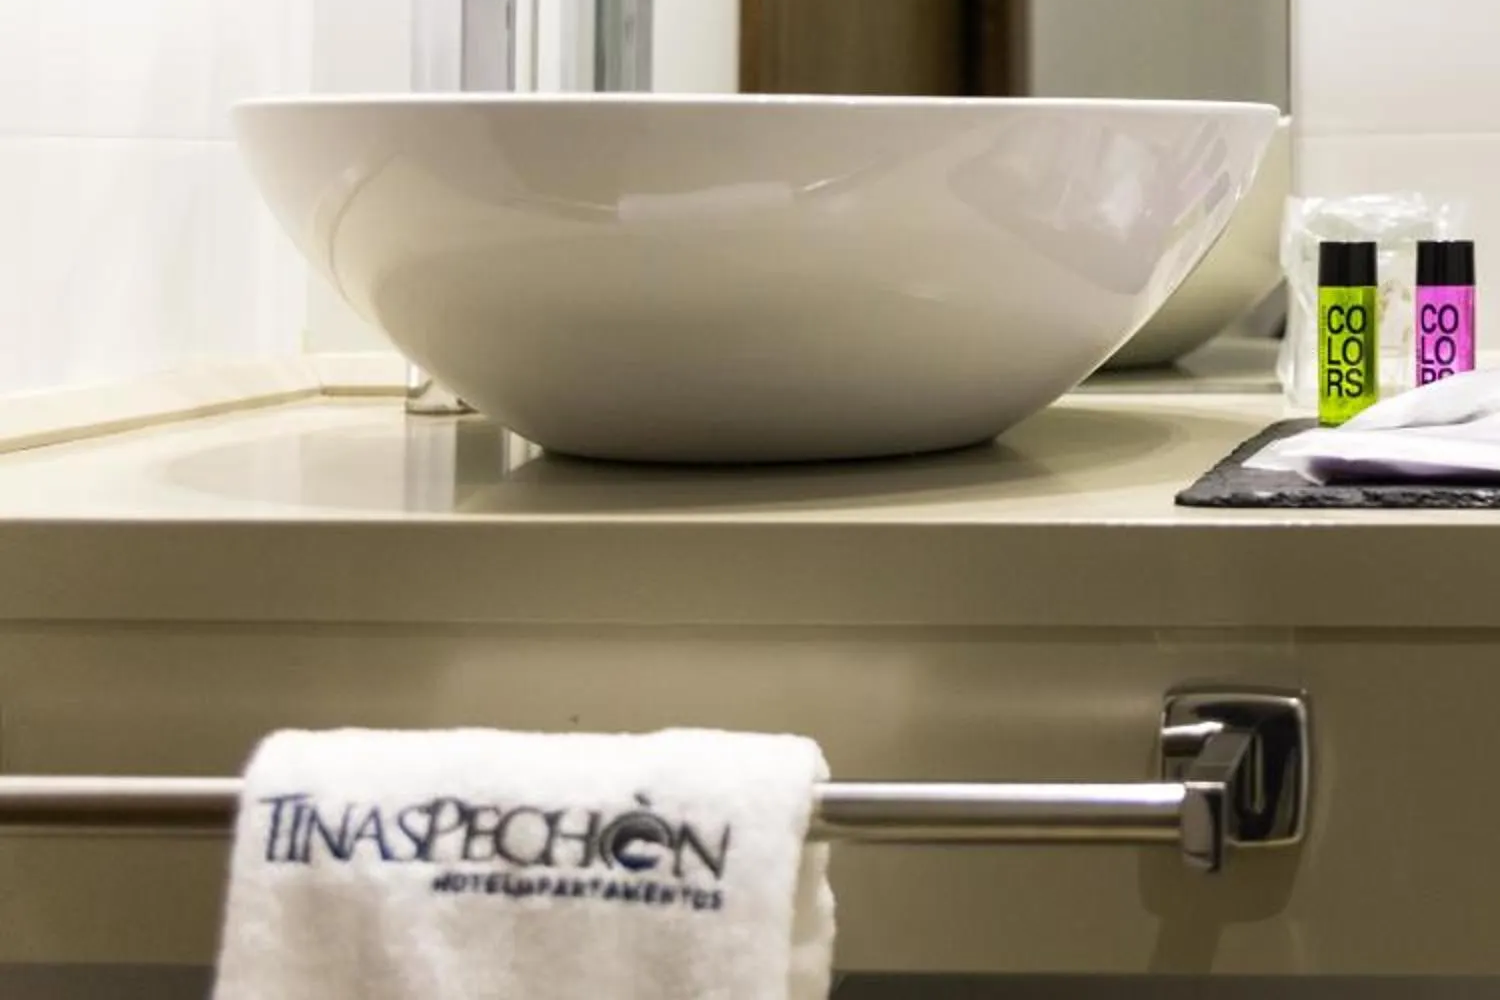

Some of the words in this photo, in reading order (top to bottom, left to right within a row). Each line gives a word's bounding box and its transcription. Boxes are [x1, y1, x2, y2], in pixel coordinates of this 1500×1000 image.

[1327, 304, 1367, 334] CO
[1421, 304, 1459, 334] CO
[1327, 336, 1363, 366] LO
[1421, 336, 1456, 365] LO
[1327, 367, 1363, 397] RS
